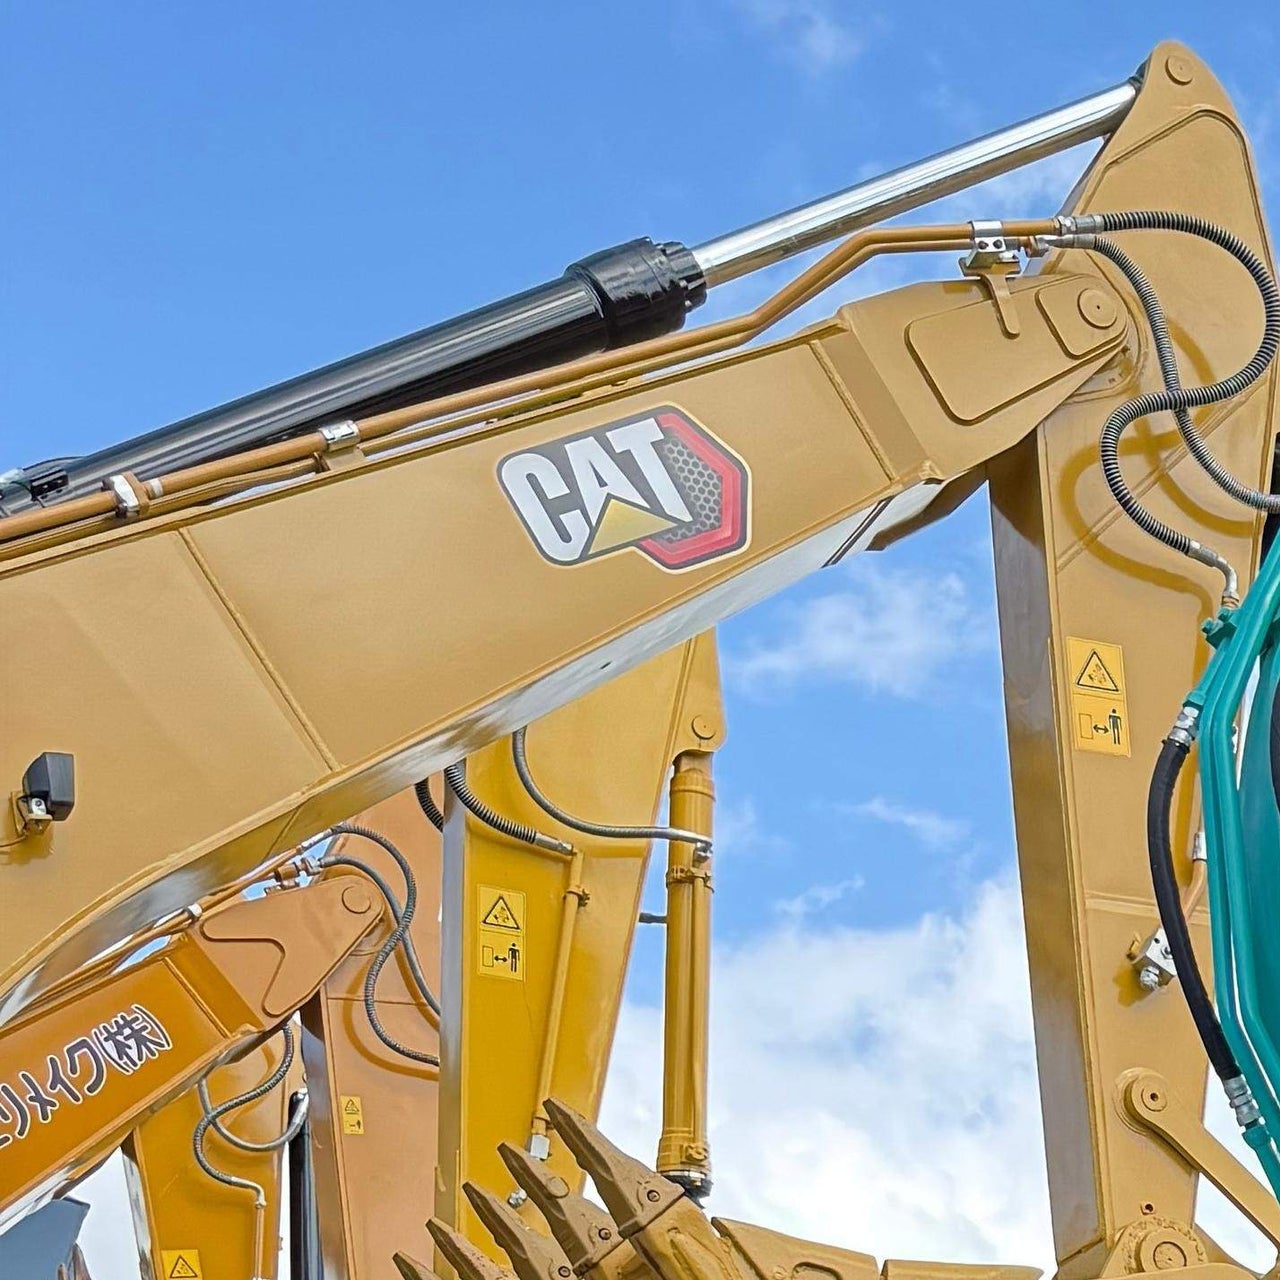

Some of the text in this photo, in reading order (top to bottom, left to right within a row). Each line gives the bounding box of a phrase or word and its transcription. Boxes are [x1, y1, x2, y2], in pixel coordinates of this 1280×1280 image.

[501, 417, 693, 562] CAT
[0, 1004, 172, 1148] リメイク(株)
